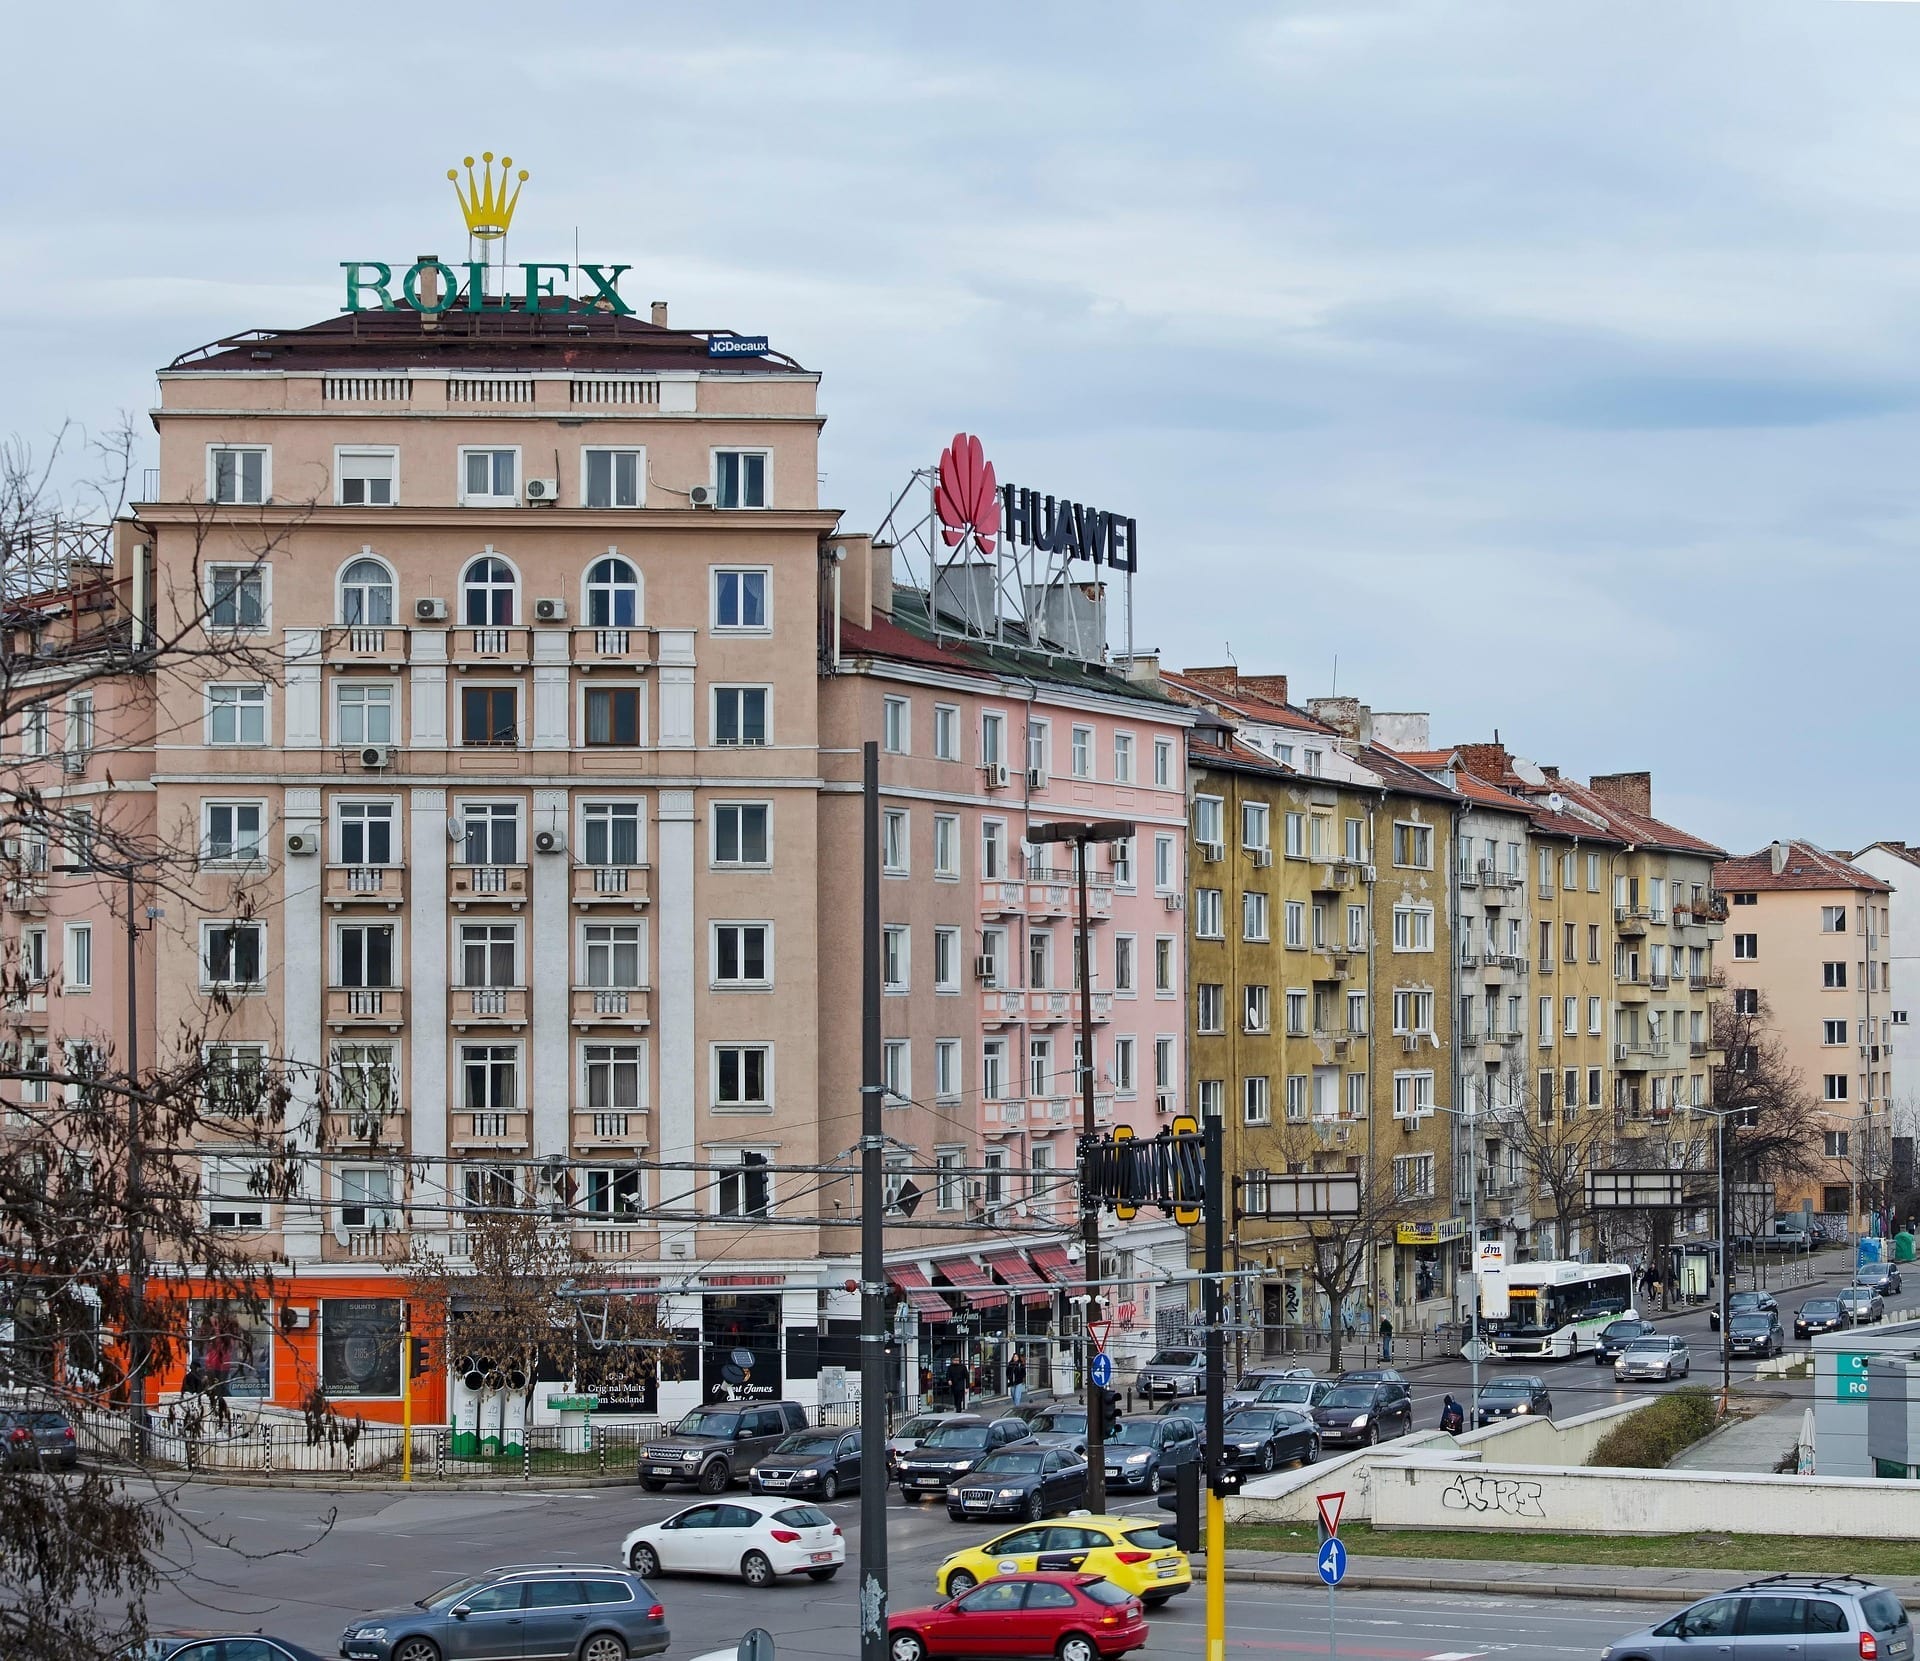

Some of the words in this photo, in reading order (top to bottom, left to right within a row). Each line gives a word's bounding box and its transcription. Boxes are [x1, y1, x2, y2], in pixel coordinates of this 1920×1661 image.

[340, 260, 636, 315] ROLEX
[710, 341, 767, 352] JCDecaux
[1006, 483, 1137, 573] HUAWEI
[1483, 1244, 1501, 1254] dm
[349, 1303, 377, 1311] SUUNTO
[743, 1383, 774, 1394] James
